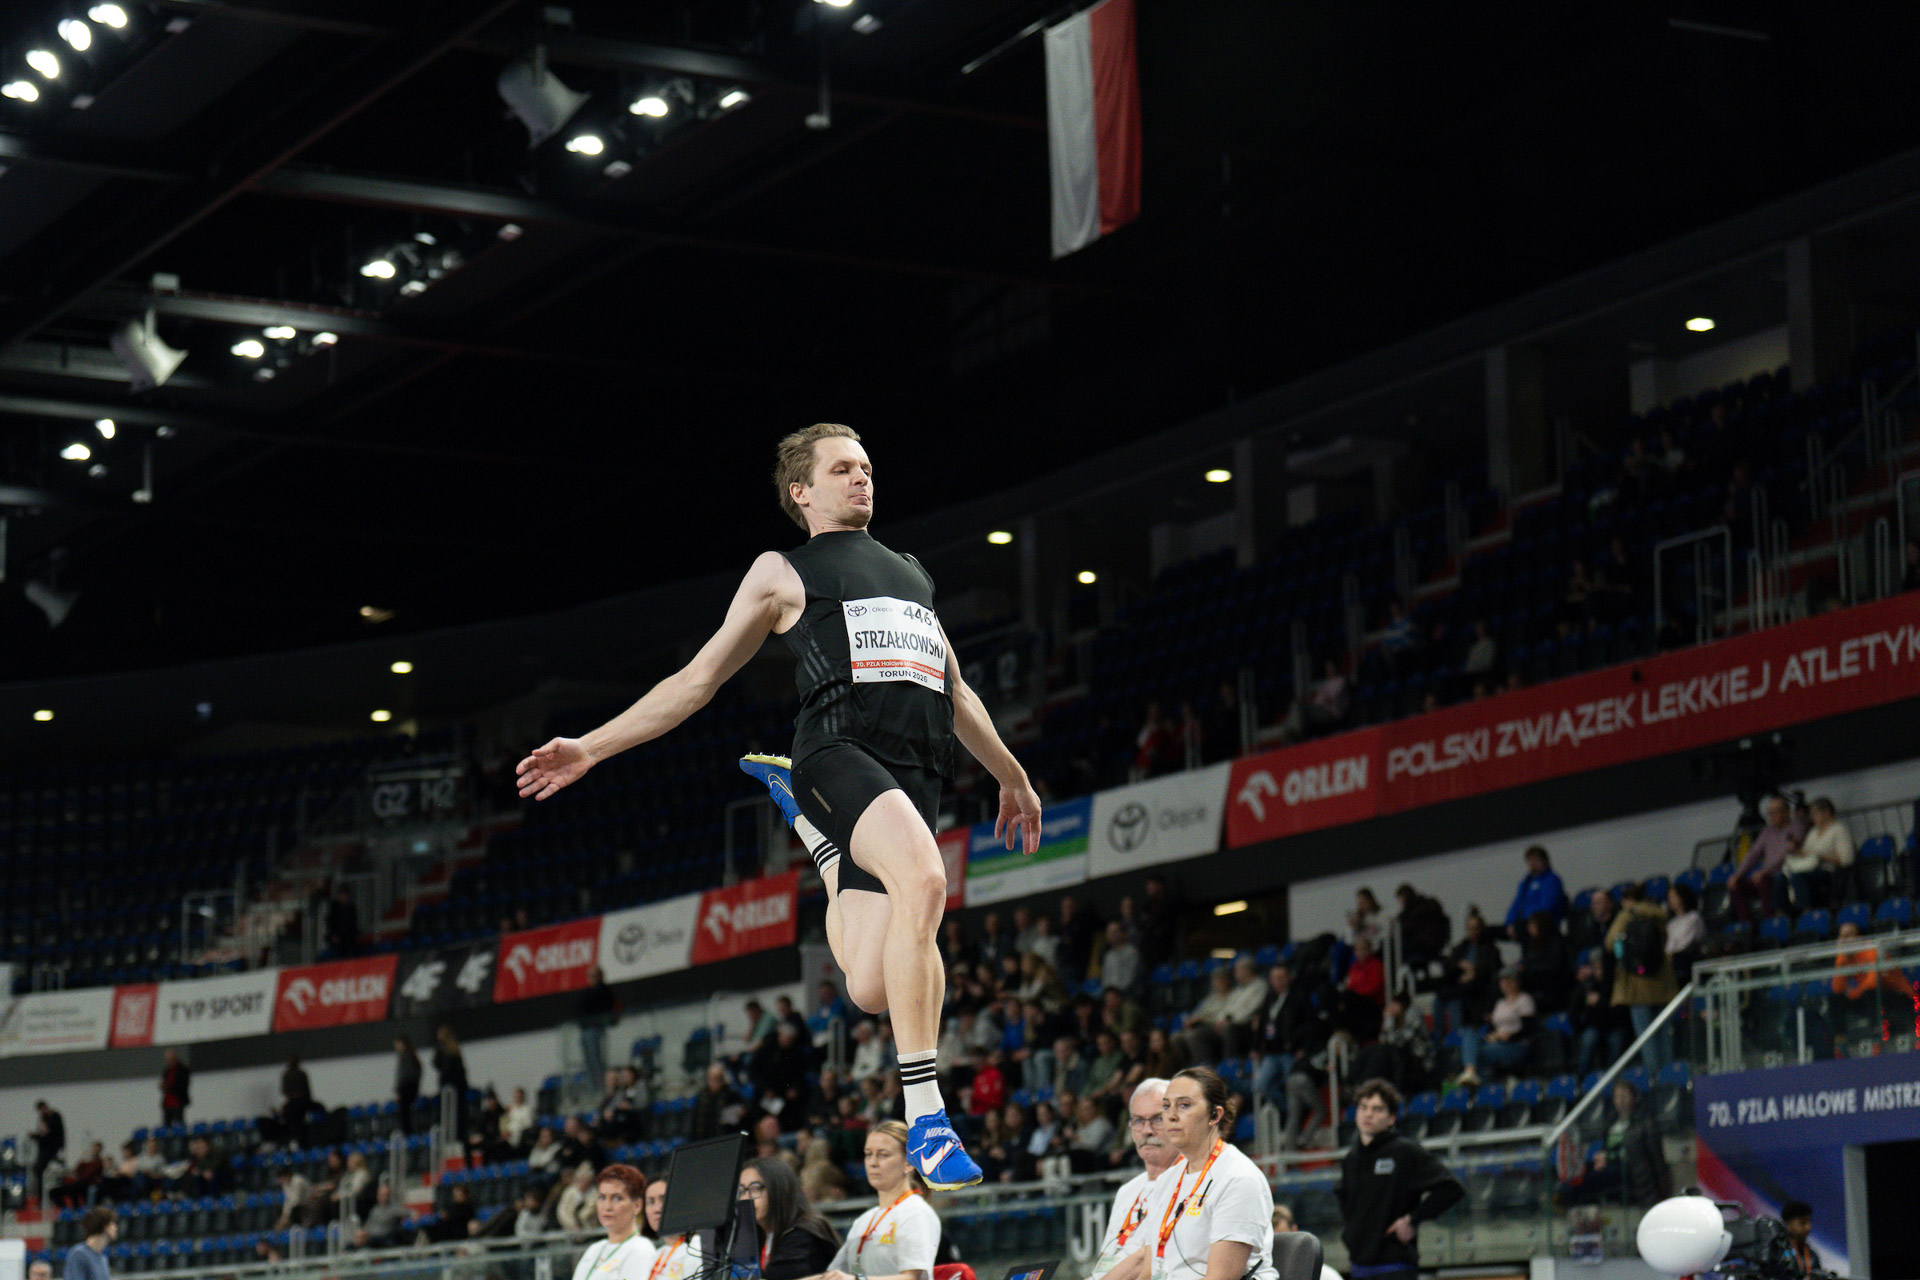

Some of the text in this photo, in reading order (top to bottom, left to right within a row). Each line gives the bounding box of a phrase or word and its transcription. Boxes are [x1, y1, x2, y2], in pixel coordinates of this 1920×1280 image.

[903, 605, 932, 626] 446
[855, 630, 944, 659] STRZAŁKOWSKI
[879, 669, 928, 683] TORUŃ 2026
[1387, 727, 1491, 782] POLSKI
[1496, 692, 1637, 758] ZWIĄZEK
[1641, 660, 1771, 724] LEKKIEJ
[1282, 755, 1369, 806] ORLEN
[731, 892, 792, 932] ORLEN
[534, 938, 595, 974] ORLEN
[170, 1001, 206, 1022] TVP
[210, 991, 264, 1020] SPORT
[319, 974, 388, 1006] ORLEN
[1708, 1100, 1734, 1128] 70.
[1737, 1097, 1779, 1125] PZLA
[1783, 1088, 1857, 1120] HALOWE
